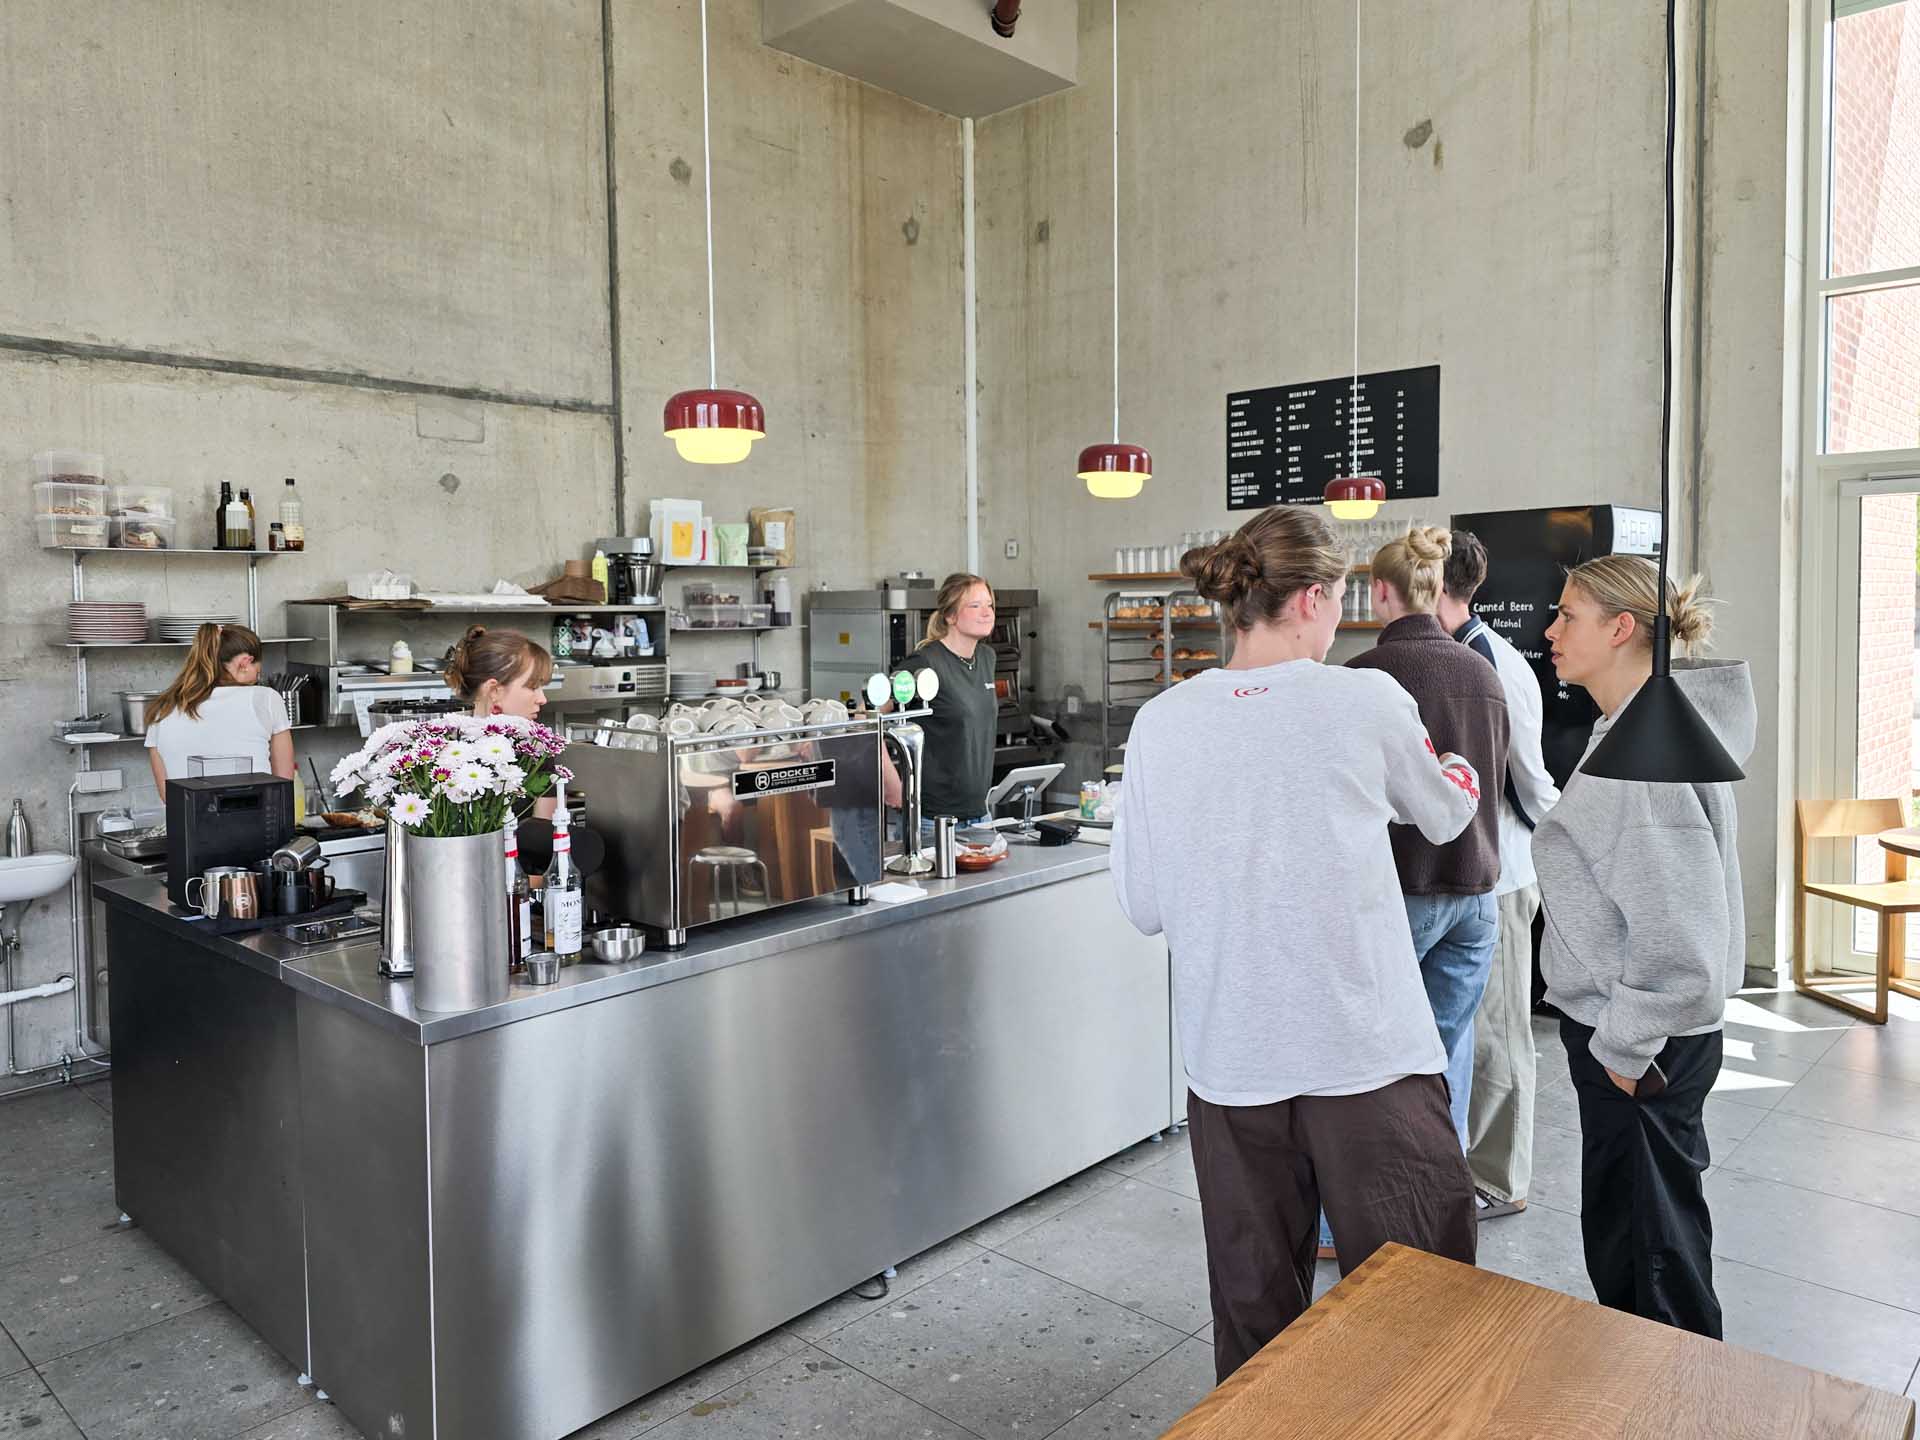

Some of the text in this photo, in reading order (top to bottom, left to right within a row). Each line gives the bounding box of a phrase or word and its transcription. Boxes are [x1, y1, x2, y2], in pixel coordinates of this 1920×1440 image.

[1473, 601, 1534, 613] Canned Beers
[1492, 618, 1522, 629] Alcohol
[771, 767, 817, 779] ROCKET
